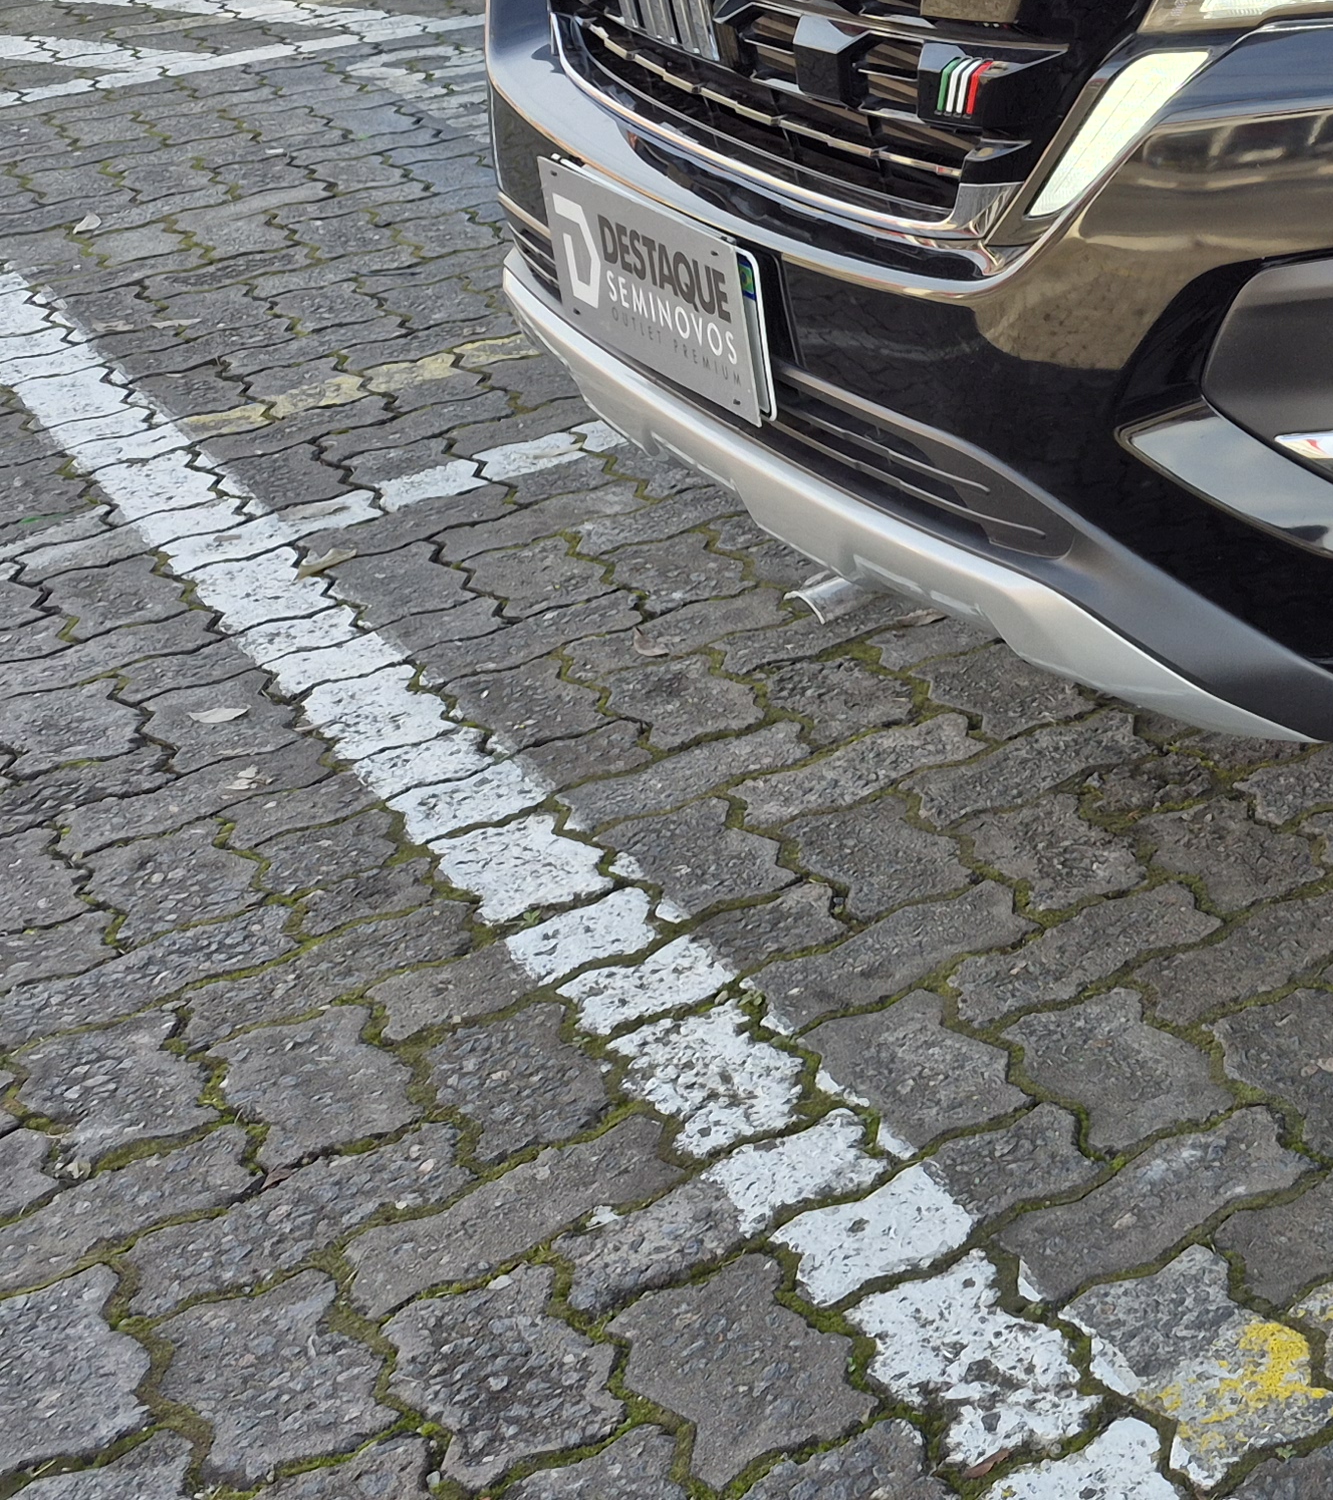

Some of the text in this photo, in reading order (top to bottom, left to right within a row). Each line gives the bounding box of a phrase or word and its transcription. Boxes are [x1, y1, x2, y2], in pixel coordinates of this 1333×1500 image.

[597, 213, 732, 324] DESTAQUE
[605, 269, 738, 366] SEMINOVOS
[611, 308, 743, 388] OUTLET PREMIUM
